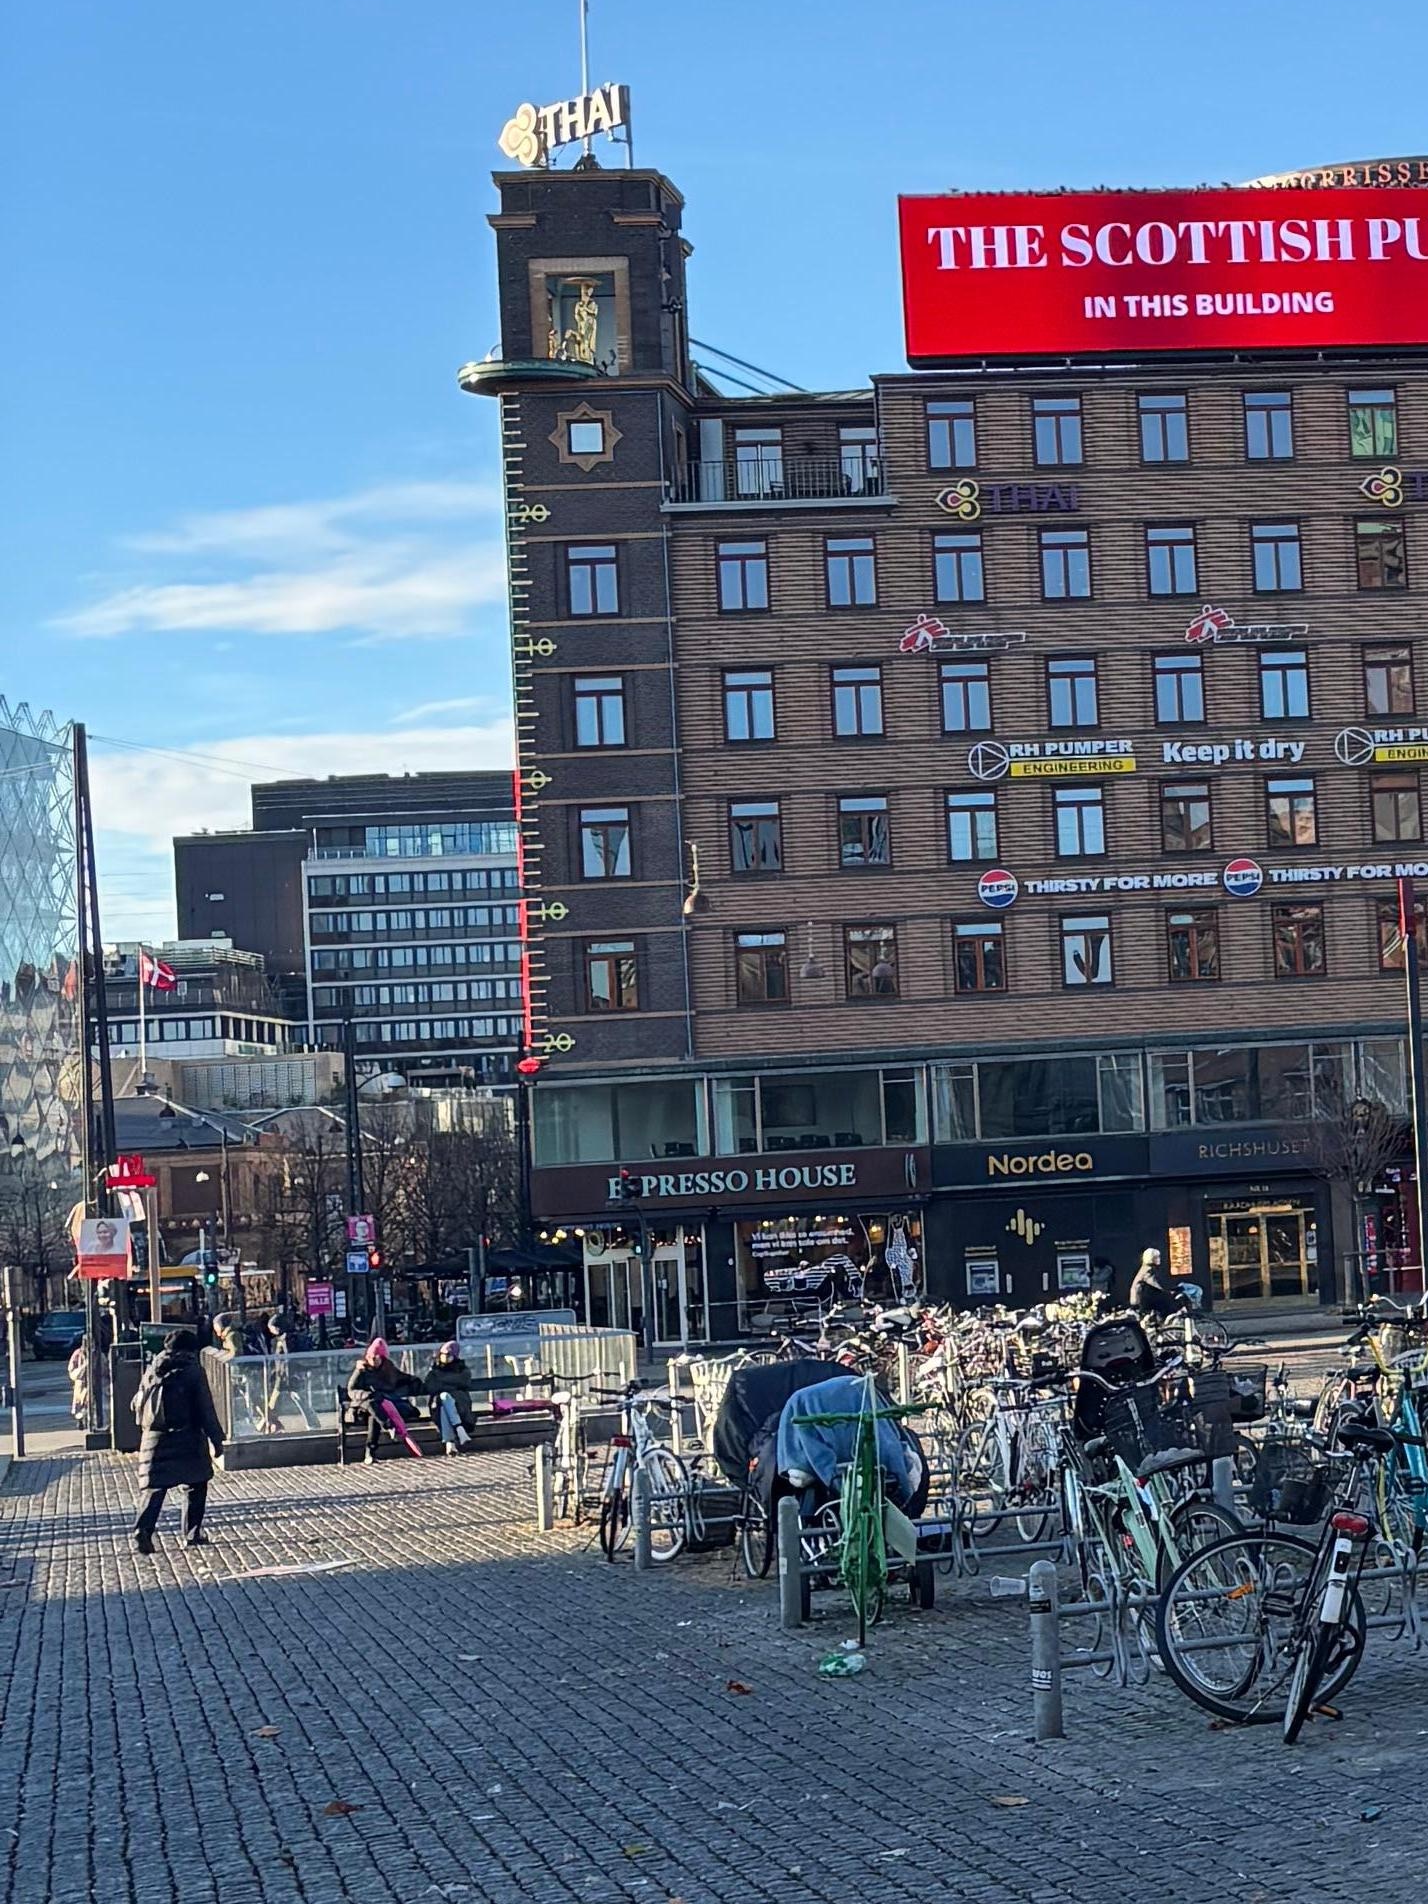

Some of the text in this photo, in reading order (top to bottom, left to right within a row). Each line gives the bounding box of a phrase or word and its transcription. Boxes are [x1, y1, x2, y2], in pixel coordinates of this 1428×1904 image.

[538, 84, 624, 147] THAI
[927, 224, 1048, 270] THE
[1060, 219, 1356, 268] SCOTTISH
[1084, 291, 1335, 319] IN THIS BUILDING
[987, 482, 1079, 513] THAI
[1009, 739, 1134, 757] RH PUMPER
[1375, 729, 1404, 742] RH
[1162, 737, 1305, 765] Keep it dry
[1023, 759, 1124, 774] ENGINEERING
[1024, 878, 1100, 894] THIRSTY
[1103, 875, 1150, 891] FOR
[1153, 872, 1218, 888] MORE
[1268, 866, 1344, 882] THIRSTY
[1346, 864, 1392, 879] FOR
[1198, 1137, 1310, 1159] RICHSHUSET
[987, 1150, 1093, 1176] Nordea
[608, 1163, 857, 1199] EPRESSO HOUSE
